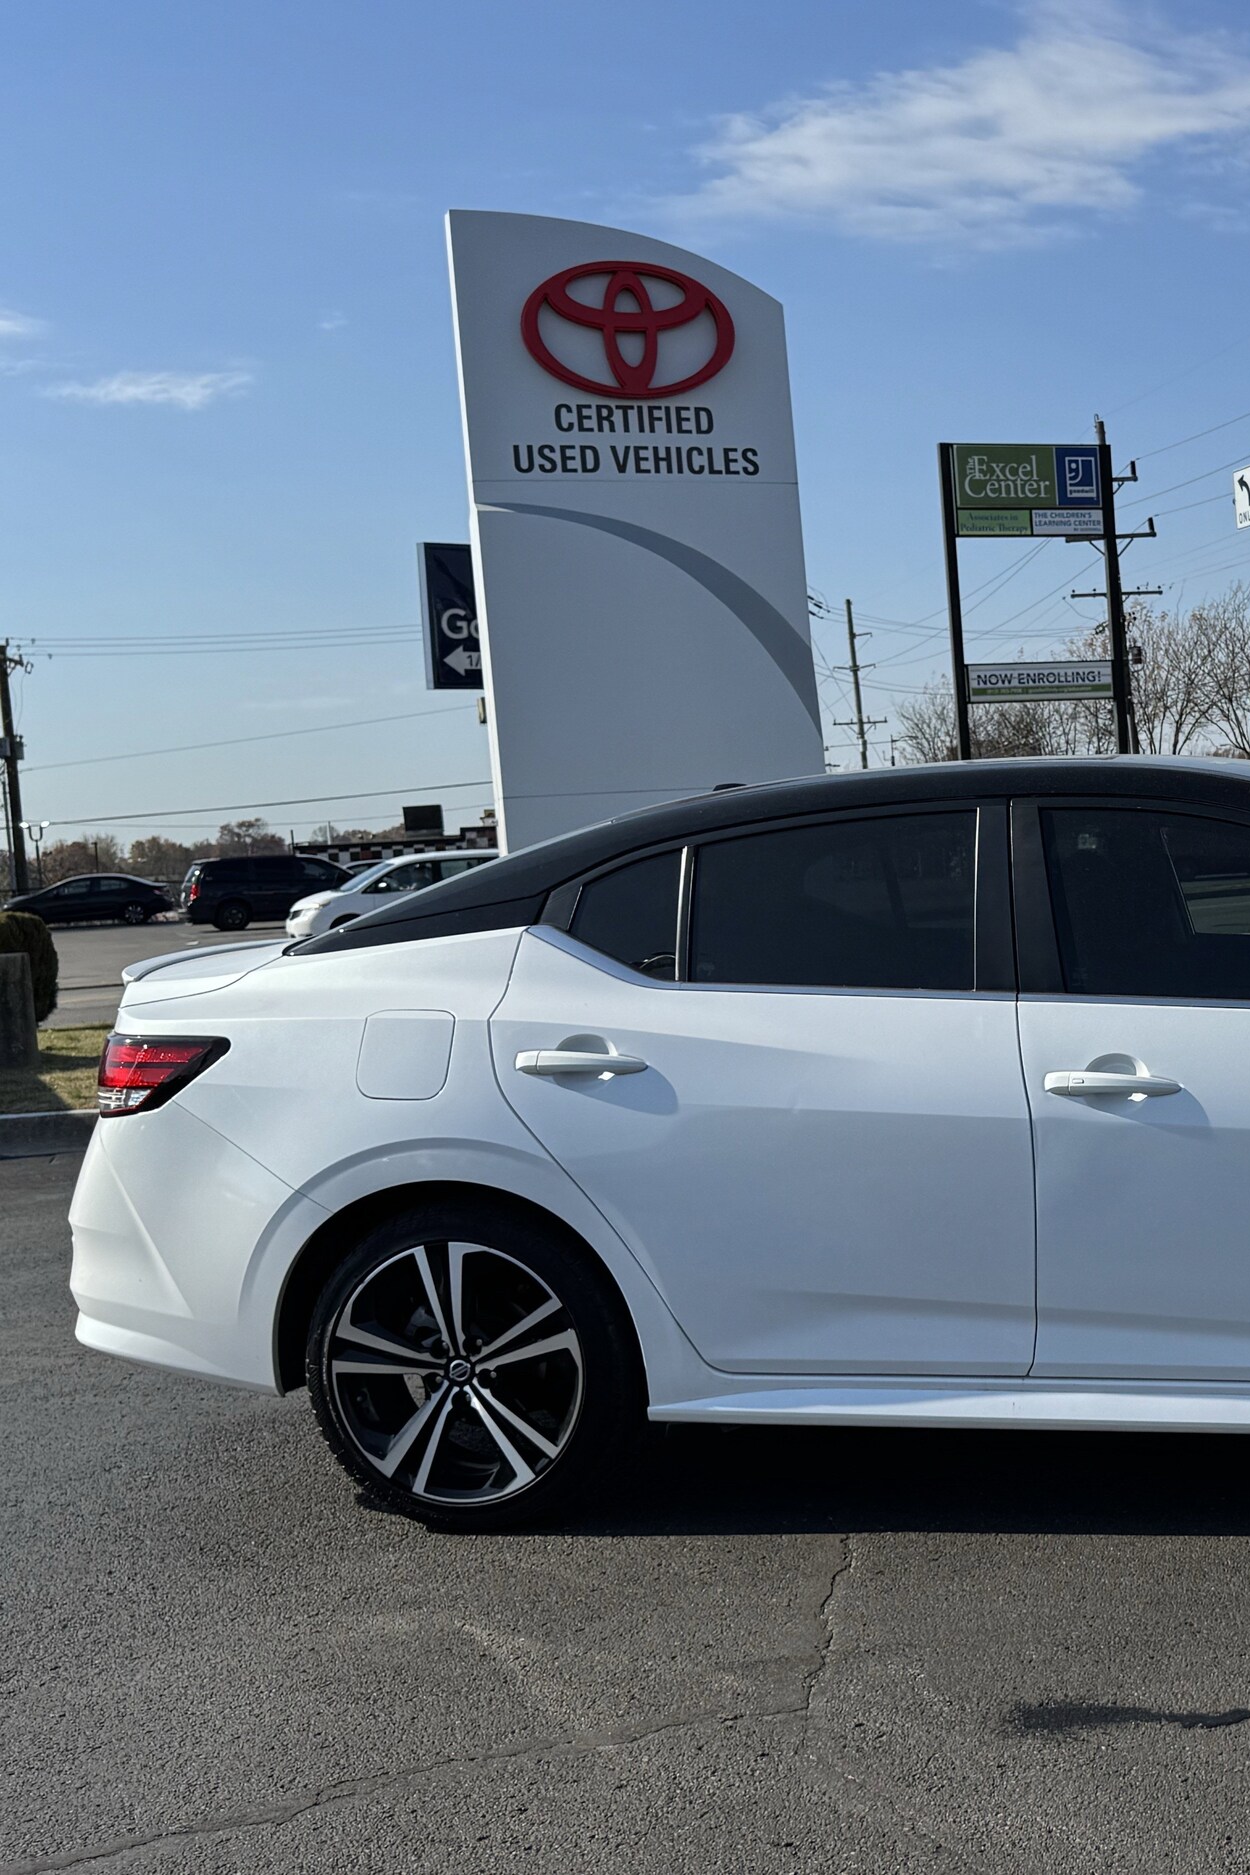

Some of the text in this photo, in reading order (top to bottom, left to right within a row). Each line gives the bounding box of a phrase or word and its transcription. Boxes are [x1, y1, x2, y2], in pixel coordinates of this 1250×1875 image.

[554, 403, 714, 435] CERTIFIED
[512, 444, 760, 476] USED VEHICLES
[972, 455, 1040, 480] Excel
[964, 473, 1050, 498] Center
[1073, 519, 1102, 527] CENTER
[976, 671, 1102, 686] NOW ENROLLING!
